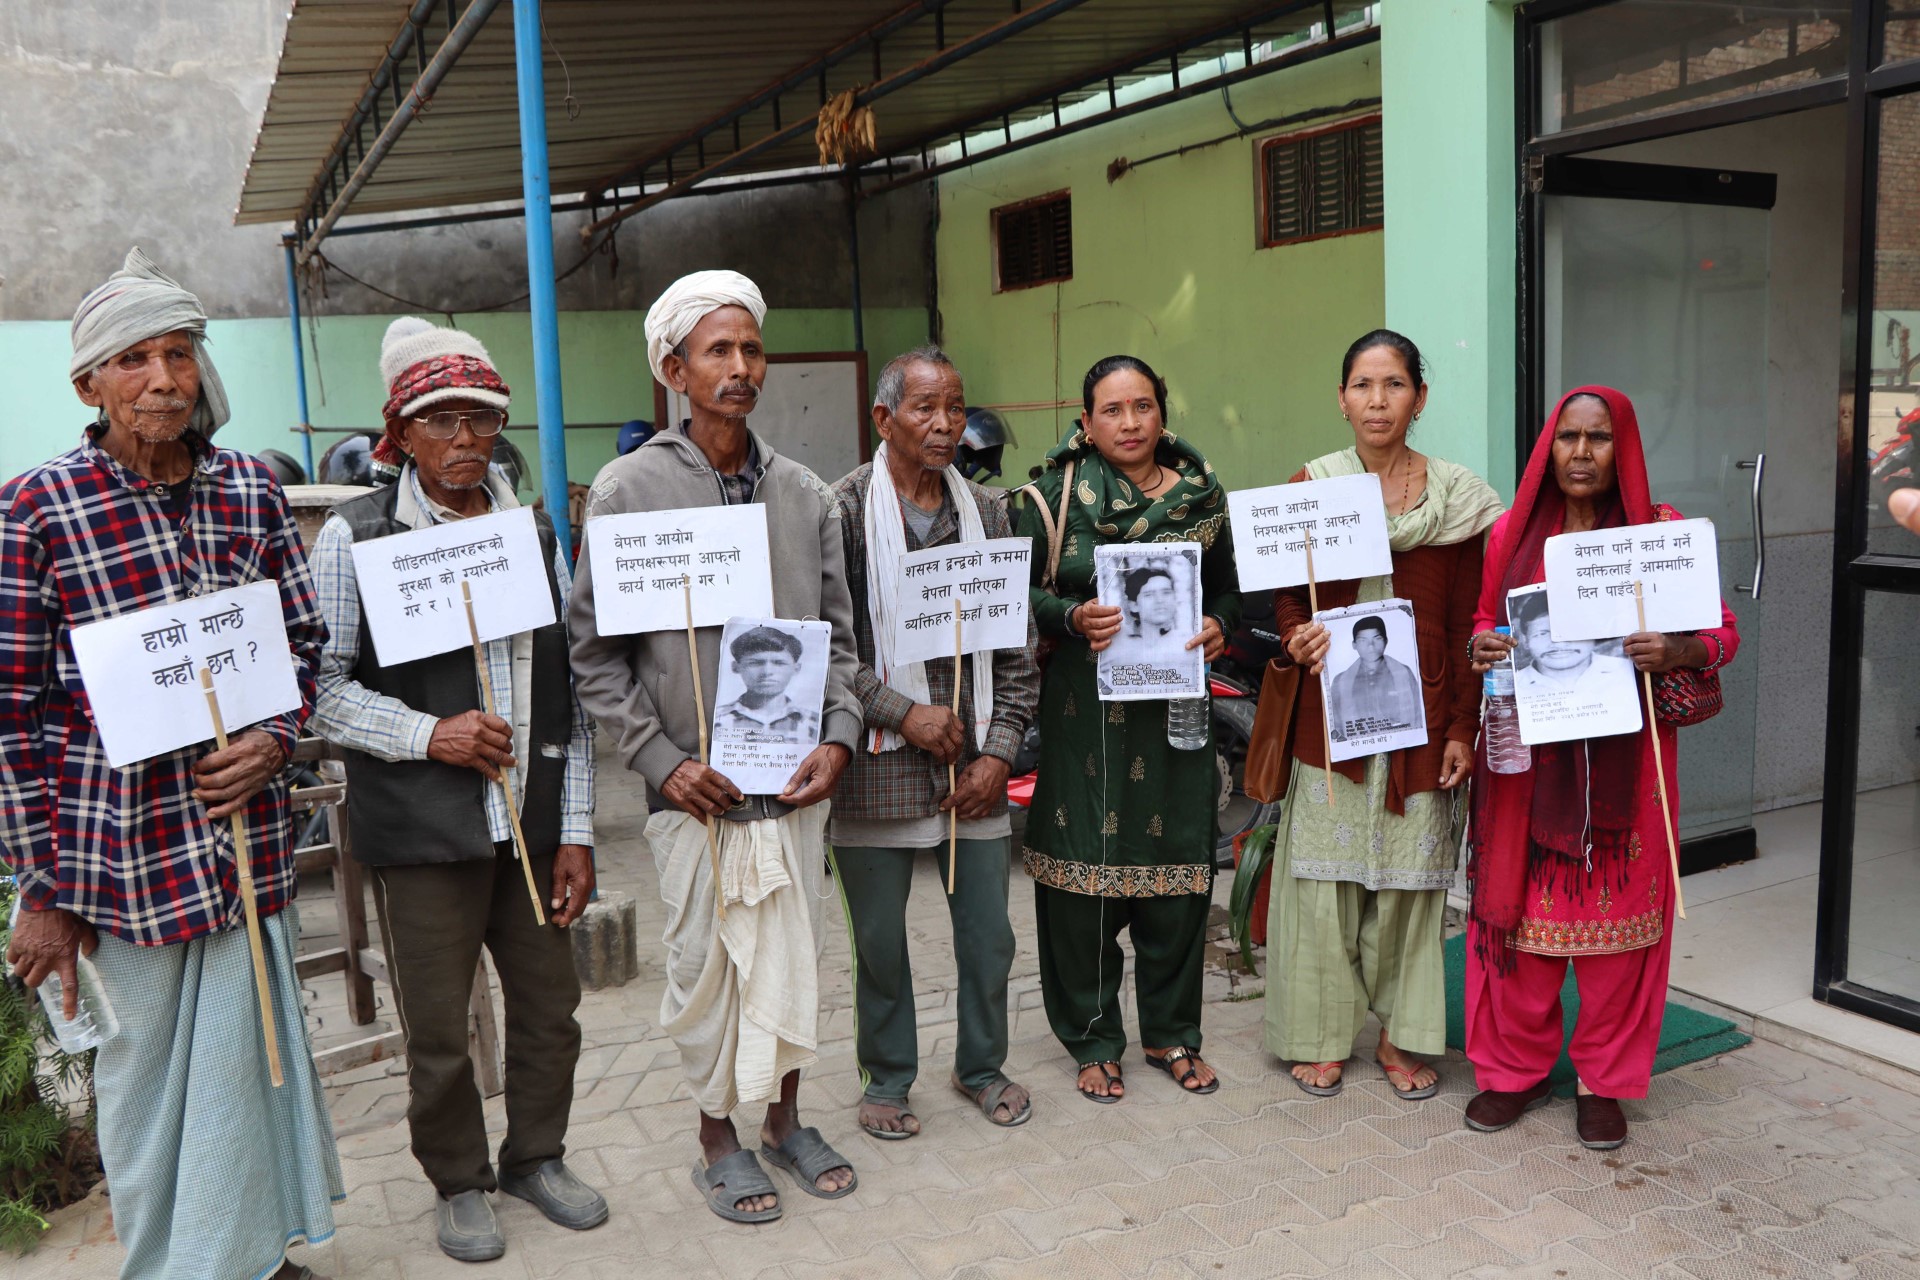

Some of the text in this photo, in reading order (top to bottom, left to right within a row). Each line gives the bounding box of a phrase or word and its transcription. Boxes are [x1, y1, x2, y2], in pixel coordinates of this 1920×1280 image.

[1285, 498, 1319, 514] आयोग
[655, 528, 694, 546] आयोग
[1257, 540, 1279, 557] कार्य
[1325, 536, 1340, 547] गर
[1612, 538, 1633, 555] पार्ने
[1640, 535, 1665, 552] कार्य
[1672, 532, 1692, 549] गर्ने
[905, 559, 941, 578] शसस्त्र
[989, 549, 1030, 564] क्रममा
[1640, 555, 1695, 573] आममाफि
[397, 556, 510, 600] सुरक्षा को ग्यारेन्ती
[618, 576, 645, 594] कार्य
[698, 573, 716, 586] गर
[959, 577, 1008, 595] पारिएका
[1577, 585, 1598, 599] दिन
[404, 603, 423, 618] गर
[428, 600, 438, 612] र
[960, 603, 983, 622] कहाँ
[988, 603, 1010, 617] छन
[1016, 601, 1022, 616] ?
[141, 602, 244, 653] हाम्रो मान्छे
[151, 641, 257, 688] कहाँ छन् ?
